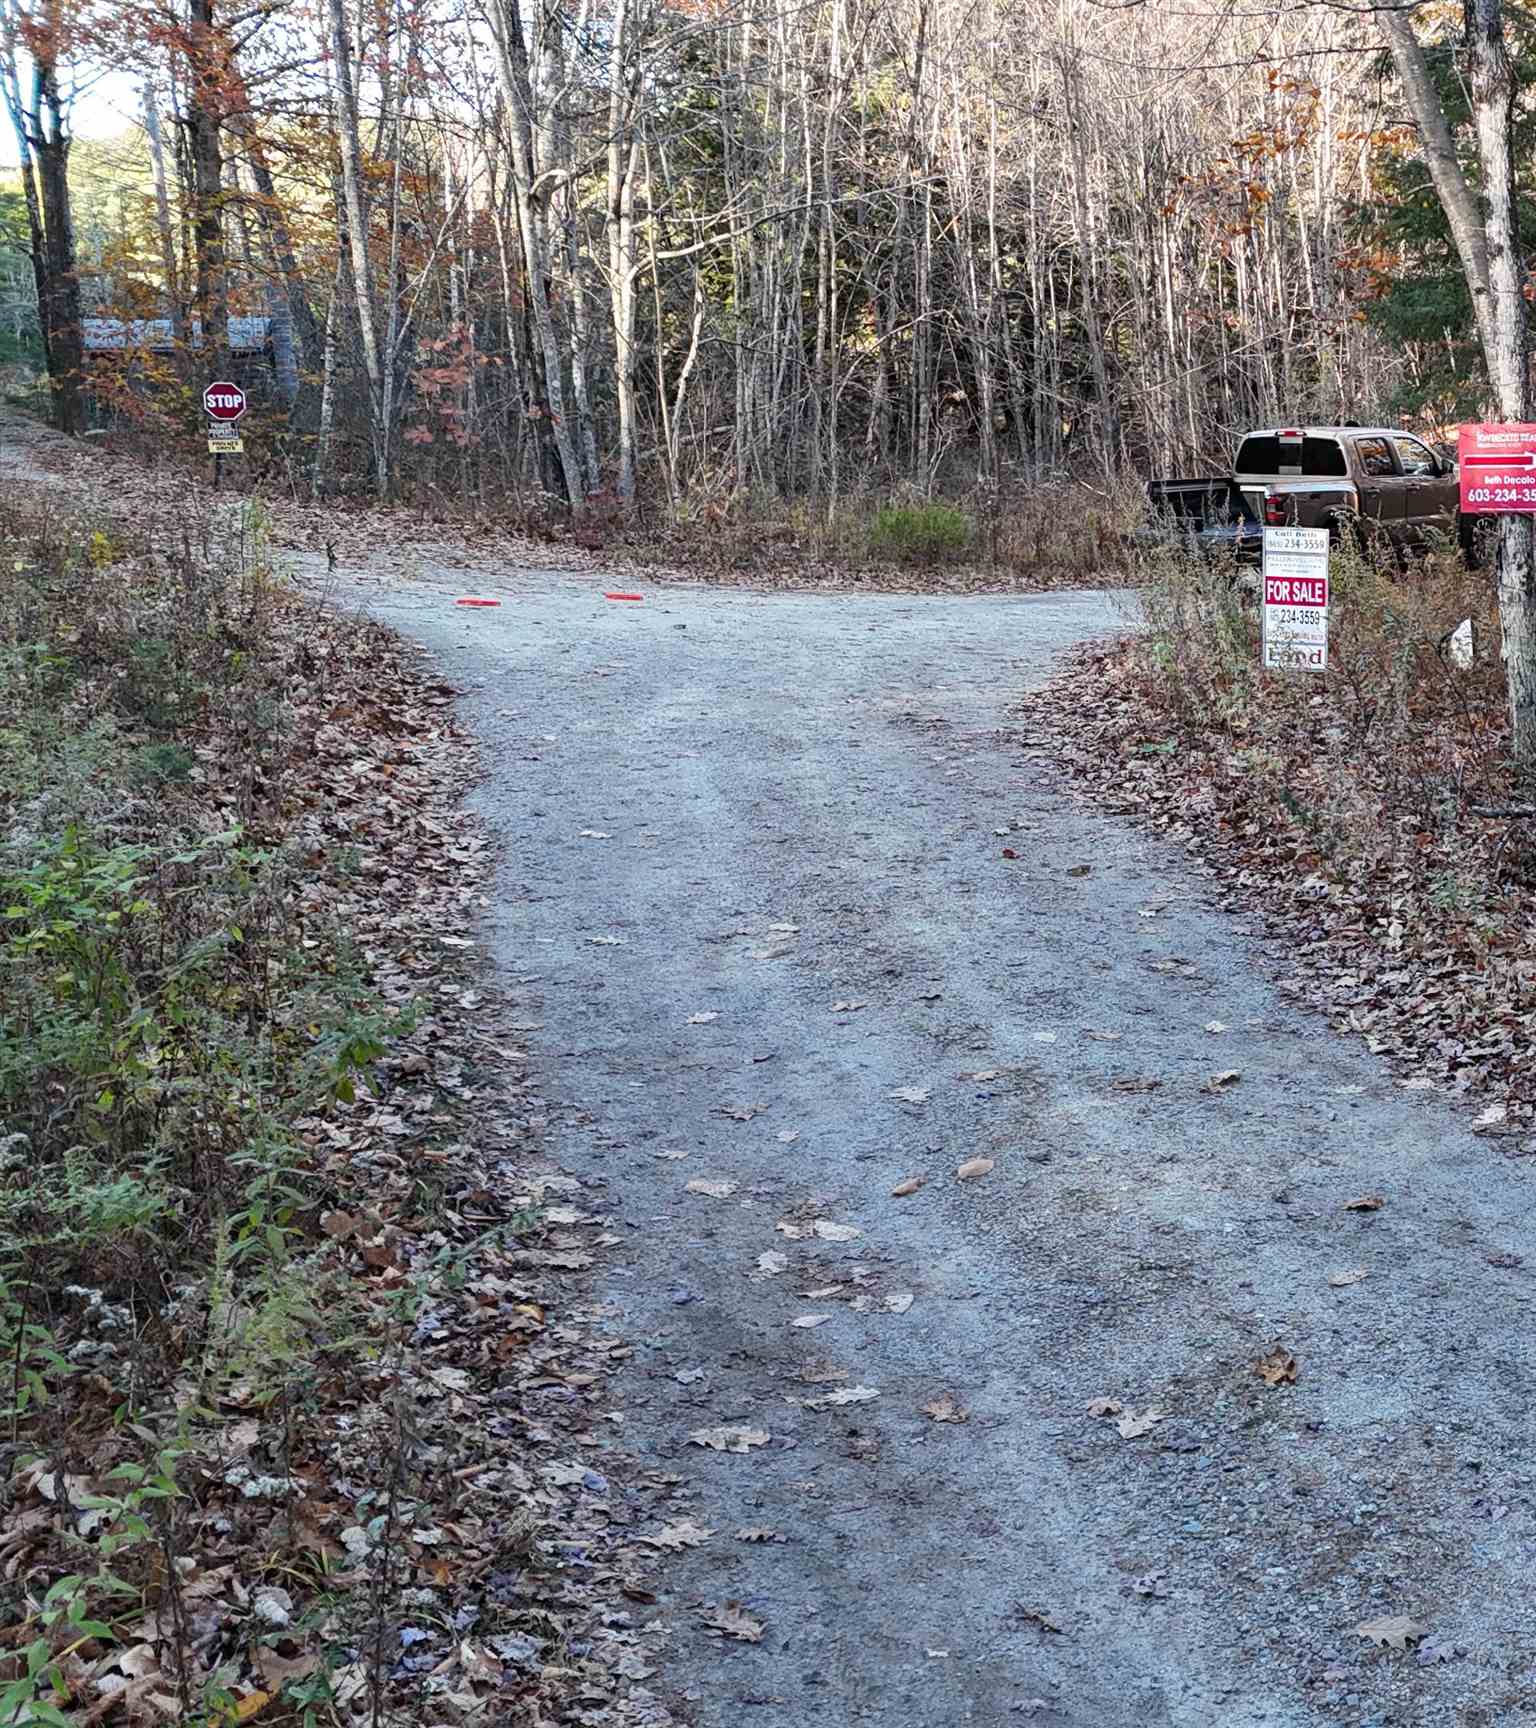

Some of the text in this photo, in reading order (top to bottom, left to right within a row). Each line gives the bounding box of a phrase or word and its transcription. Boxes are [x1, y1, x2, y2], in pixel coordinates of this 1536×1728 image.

[207, 394, 242, 408] STOP
[1284, 538, 1325, 549] 234-3559
[1266, 580, 1323, 603] FOR SALE
[1280, 608, 1320, 625] 234-3559
